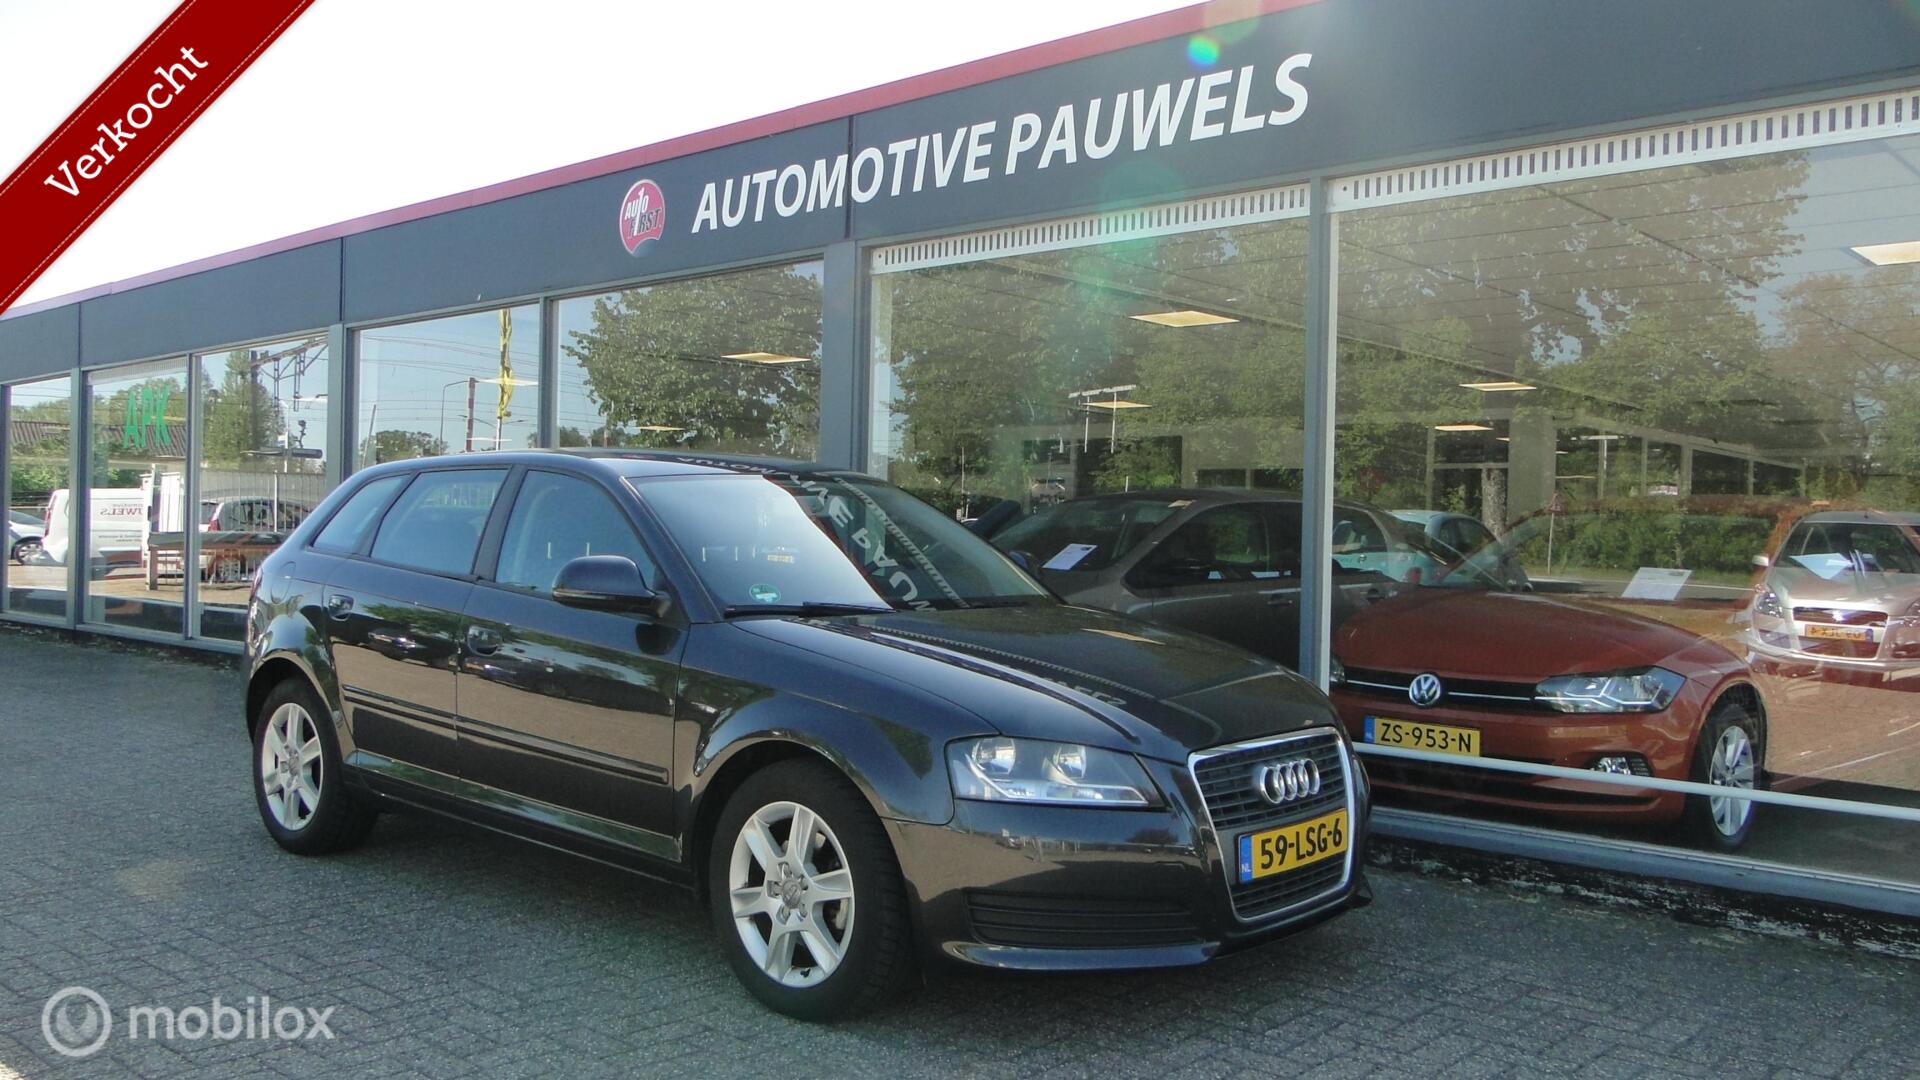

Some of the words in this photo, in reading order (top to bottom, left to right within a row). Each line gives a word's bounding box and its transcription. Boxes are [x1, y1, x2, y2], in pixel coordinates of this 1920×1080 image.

[691, 120, 997, 235] AUTOMOTIVE
[1005, 52, 1313, 177] PAUWELS
[123, 384, 171, 449] APK
[1380, 722, 1471, 753] ZS-953-N
[1260, 817, 1343, 870] 59-LSG-6
